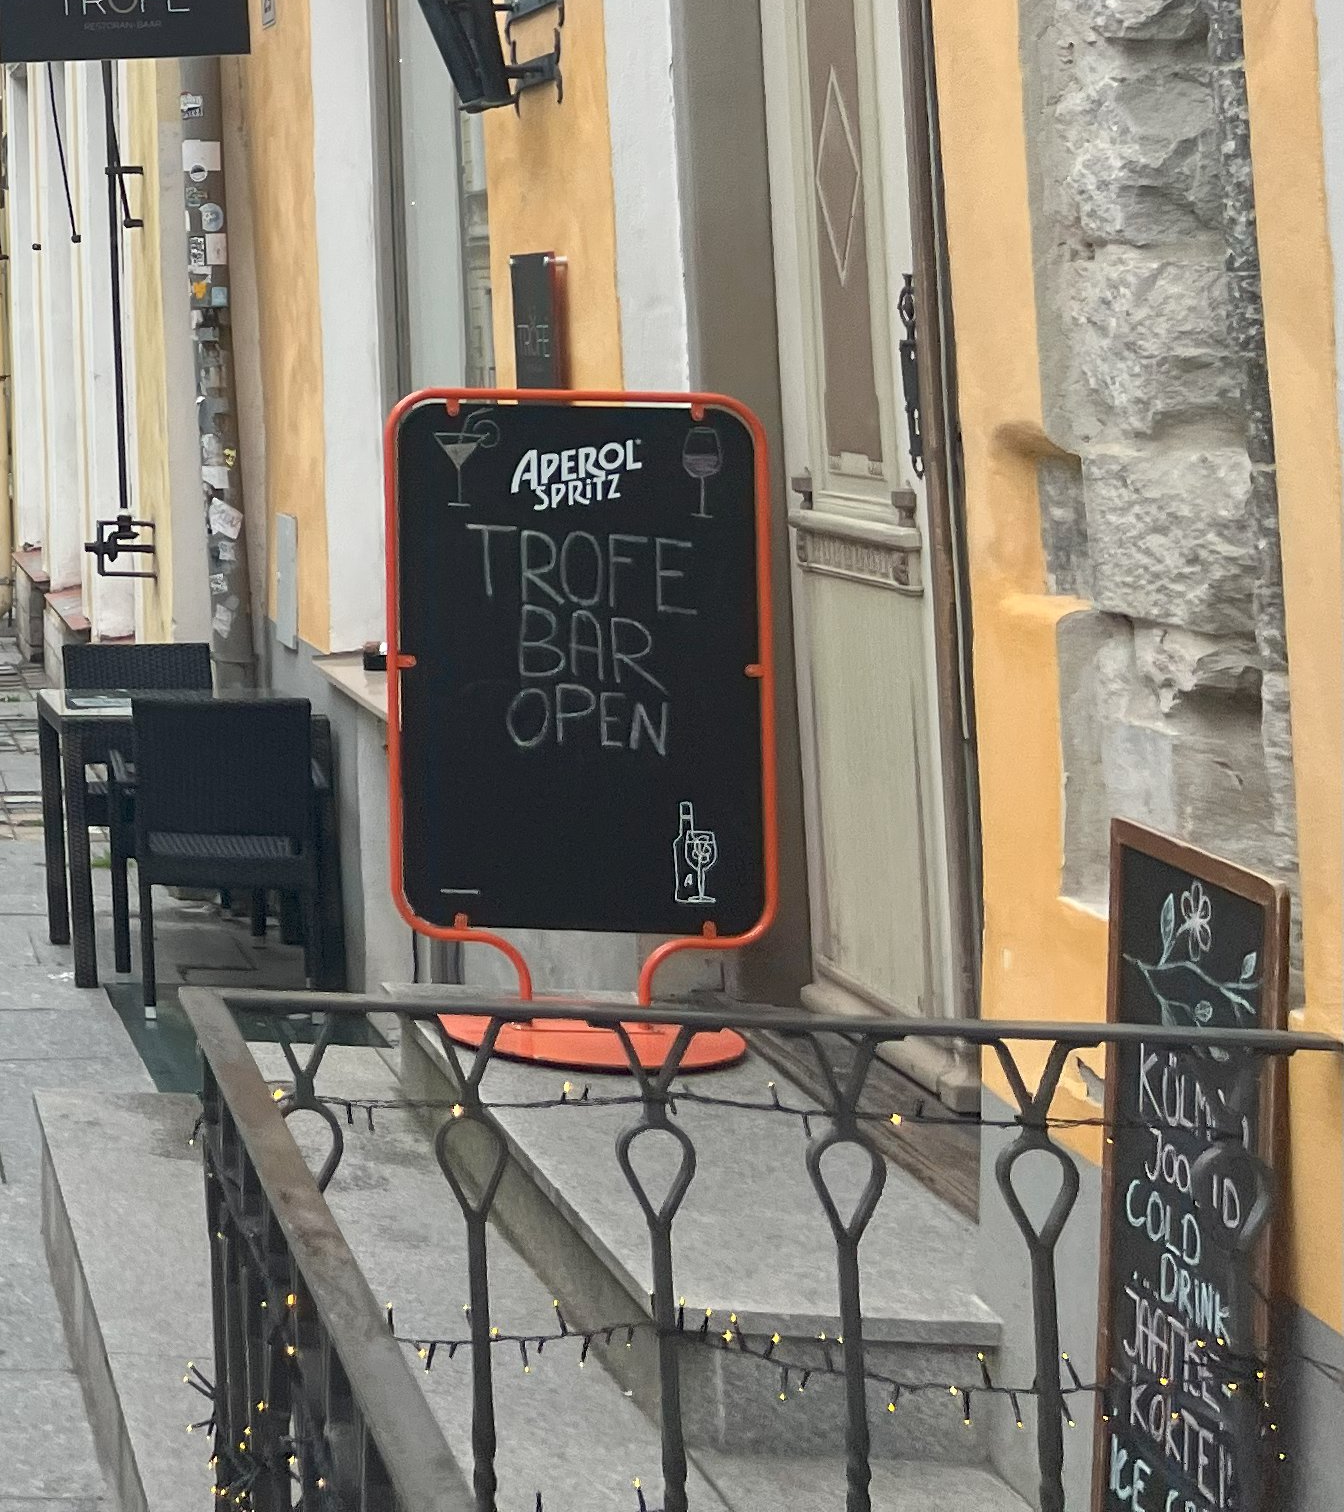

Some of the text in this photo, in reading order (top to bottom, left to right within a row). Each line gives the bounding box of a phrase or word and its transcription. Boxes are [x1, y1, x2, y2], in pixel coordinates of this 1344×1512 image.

[510, 439, 643, 494] APEROL
[465, 522, 698, 616] TROFE
[518, 603, 670, 696] BAR
[506, 683, 668, 757] OPEN
[1126, 1179, 1201, 1266] COLD
[1144, 1126, 1240, 1229] JOOID
